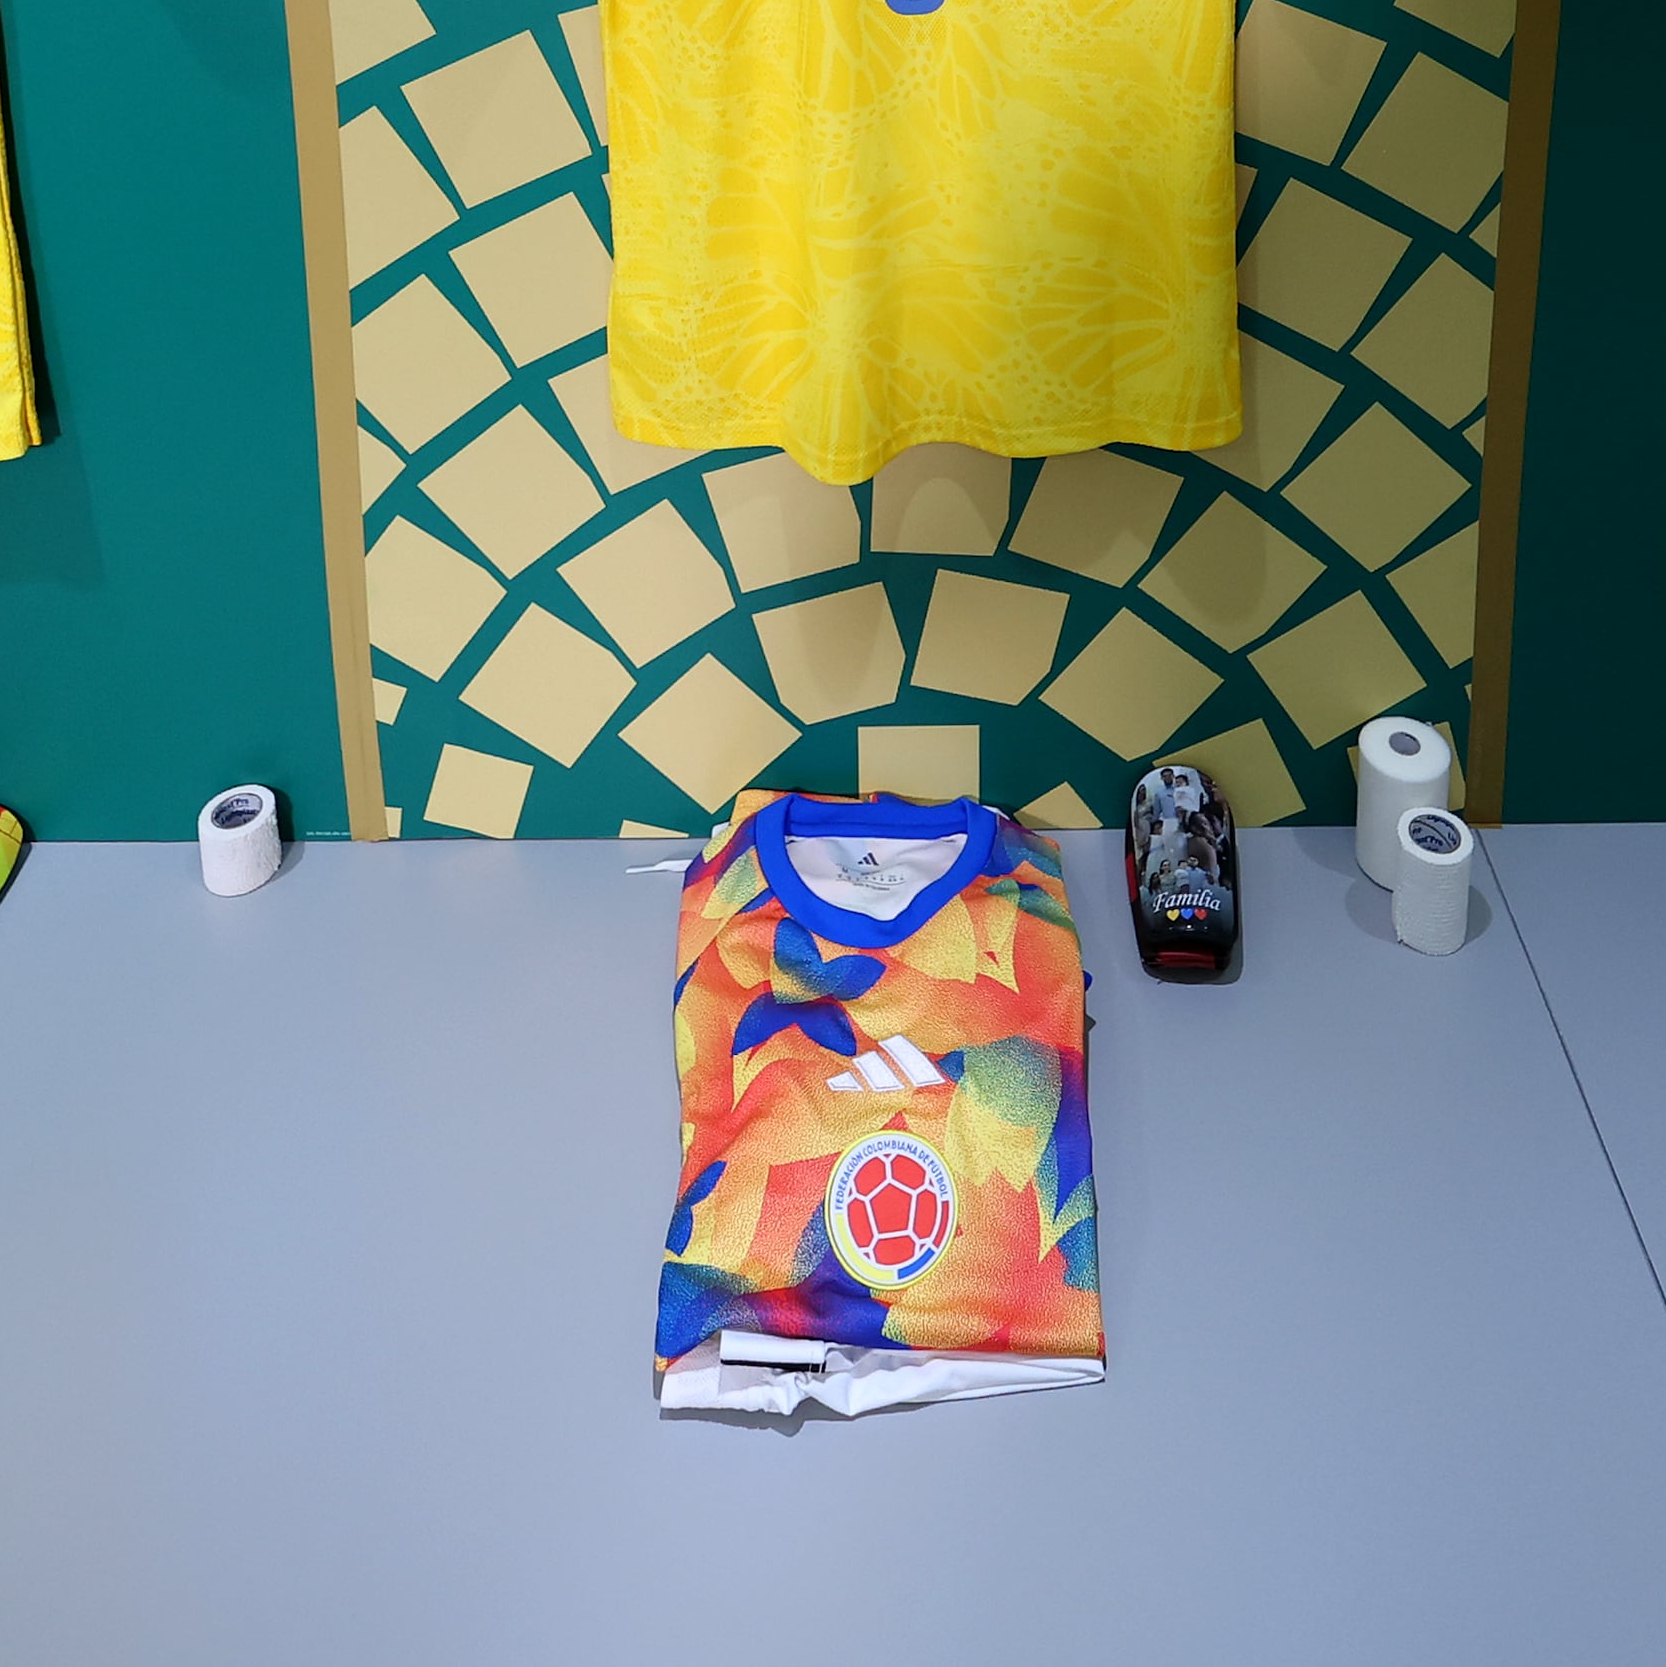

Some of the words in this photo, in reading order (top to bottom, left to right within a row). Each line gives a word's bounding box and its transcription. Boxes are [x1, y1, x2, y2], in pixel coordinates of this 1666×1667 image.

[1152, 889, 1221, 913] Familia
[863, 1139, 918, 1157] COLOMBIANA
[918, 1150, 931, 1164] DE
